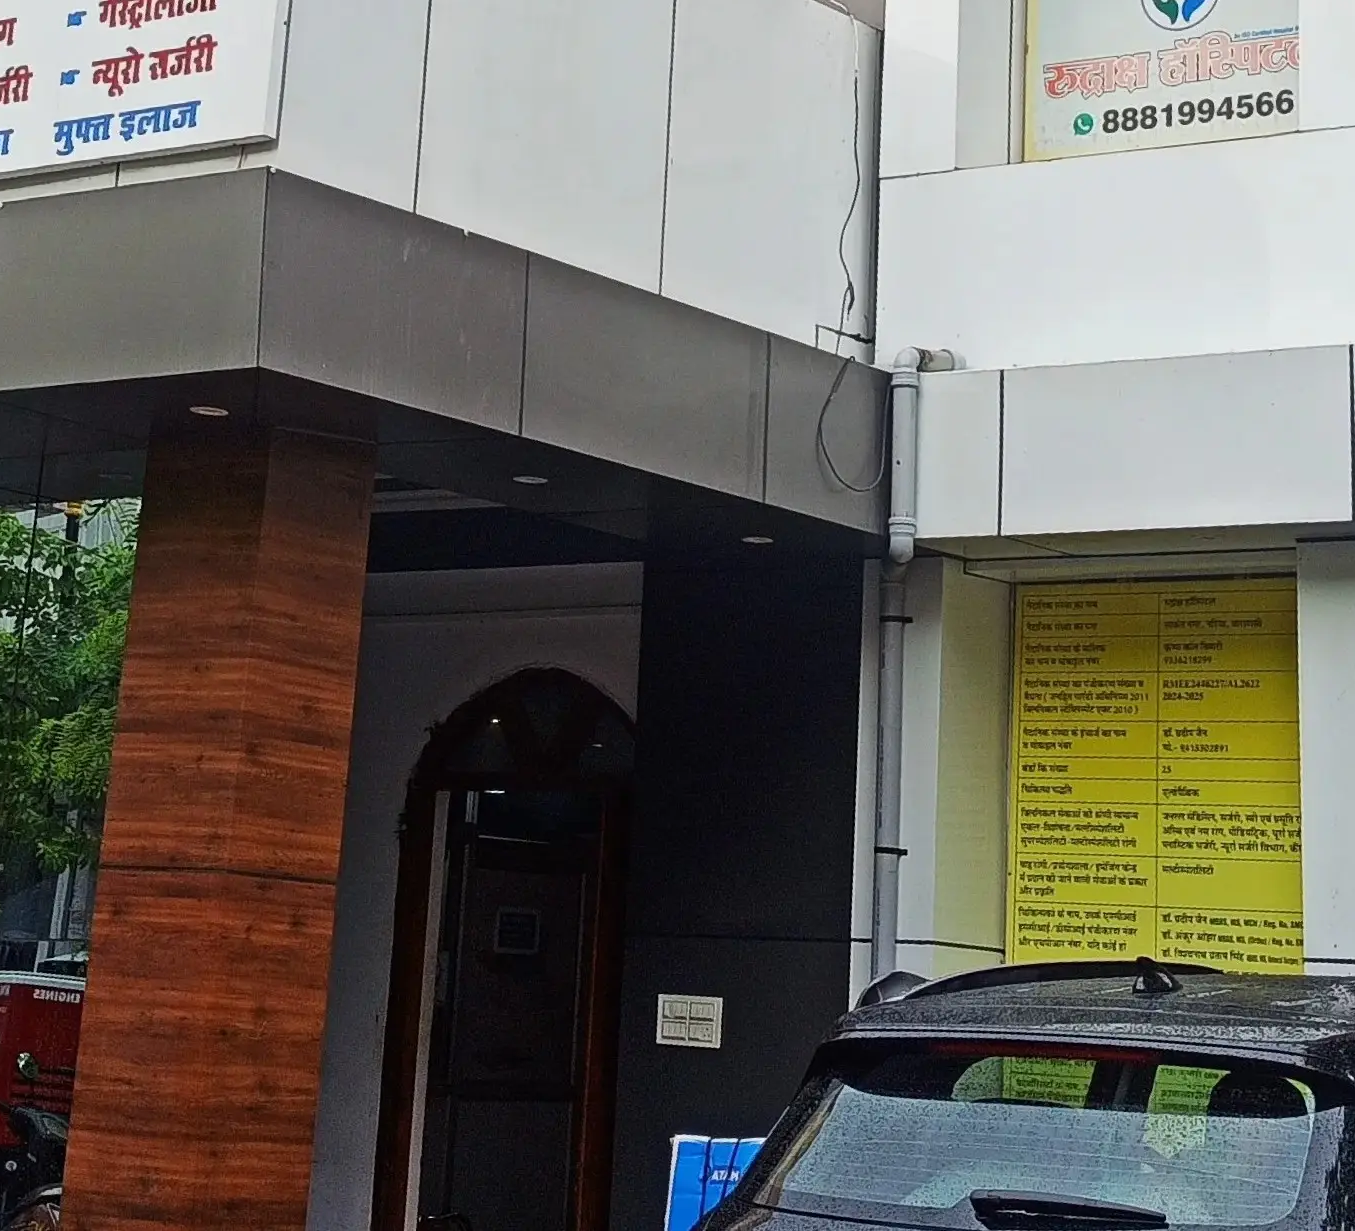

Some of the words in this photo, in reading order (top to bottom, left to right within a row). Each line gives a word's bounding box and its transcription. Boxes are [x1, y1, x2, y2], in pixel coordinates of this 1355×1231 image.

[92, 47, 144, 97] न्यूरो
[149, 34, 217, 80] सर्जरी
[1043, 52, 1151, 99] रुद्राक्ष
[54, 114, 114, 155] मुफ्त
[119, 101, 201, 141] इलाज
[1102, 89, 1295, 134] 8881994566
[1161, 765, 1172, 774] 25
